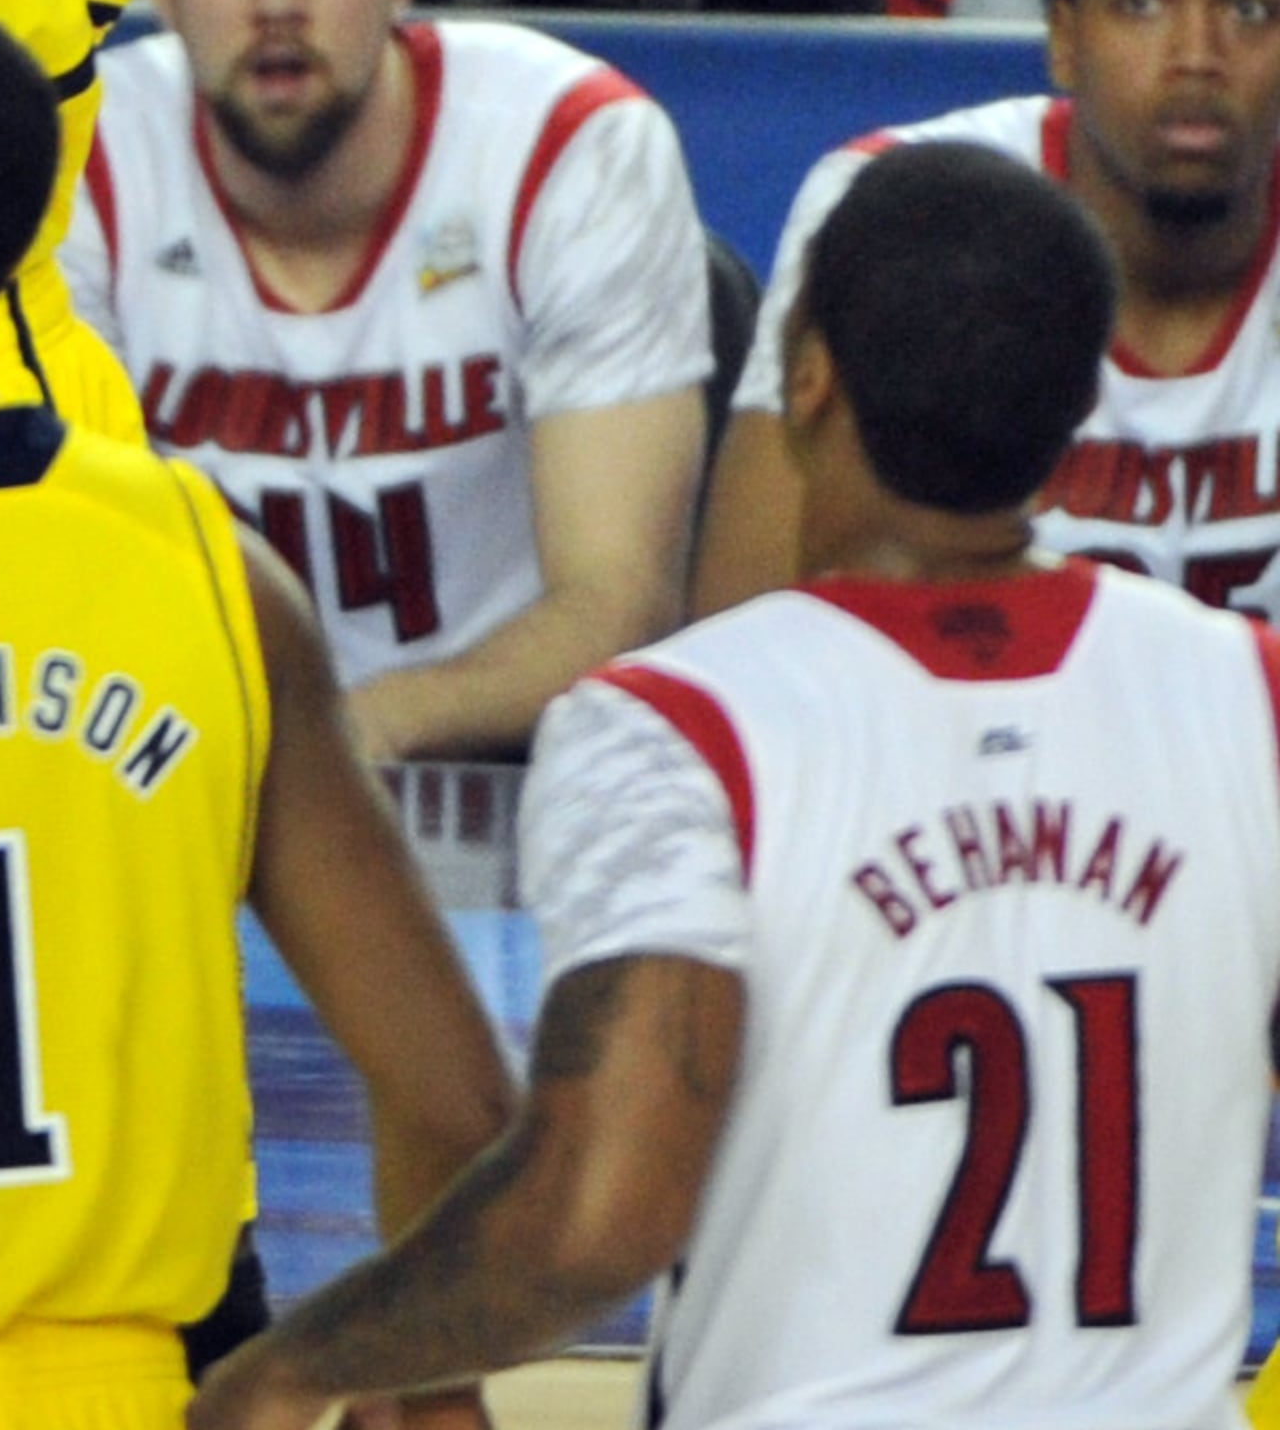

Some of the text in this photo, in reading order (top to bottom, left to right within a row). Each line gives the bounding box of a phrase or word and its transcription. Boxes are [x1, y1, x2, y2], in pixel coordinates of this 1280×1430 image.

[142, 351, 507, 459] LOUISVILLE
[852, 797, 1183, 940] BEHANAN
[890, 971, 1139, 1336] 21
